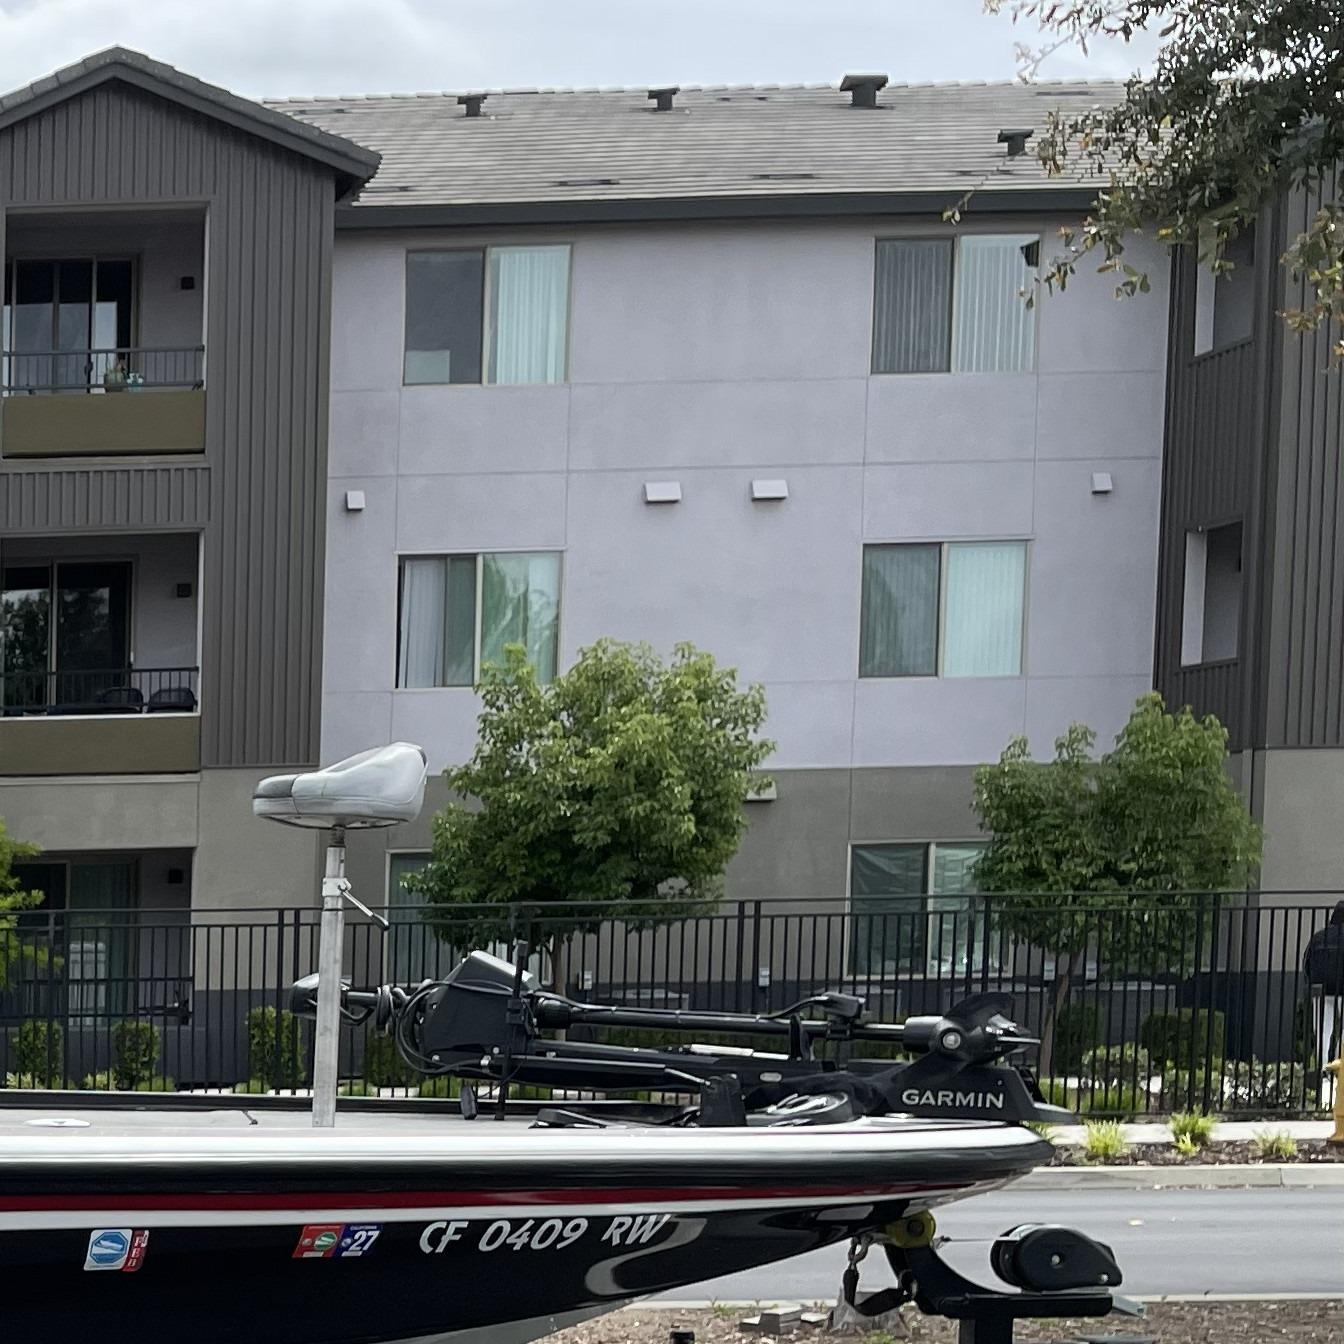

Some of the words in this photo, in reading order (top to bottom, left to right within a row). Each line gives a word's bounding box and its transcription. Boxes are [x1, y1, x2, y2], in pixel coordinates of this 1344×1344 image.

[901, 1088, 1005, 1109] GARMIN
[348, 1230, 381, 1251] 27
[418, 1220, 469, 1254] CF
[478, 1217, 589, 1252] 0409
[600, 1213, 672, 1247] RW
